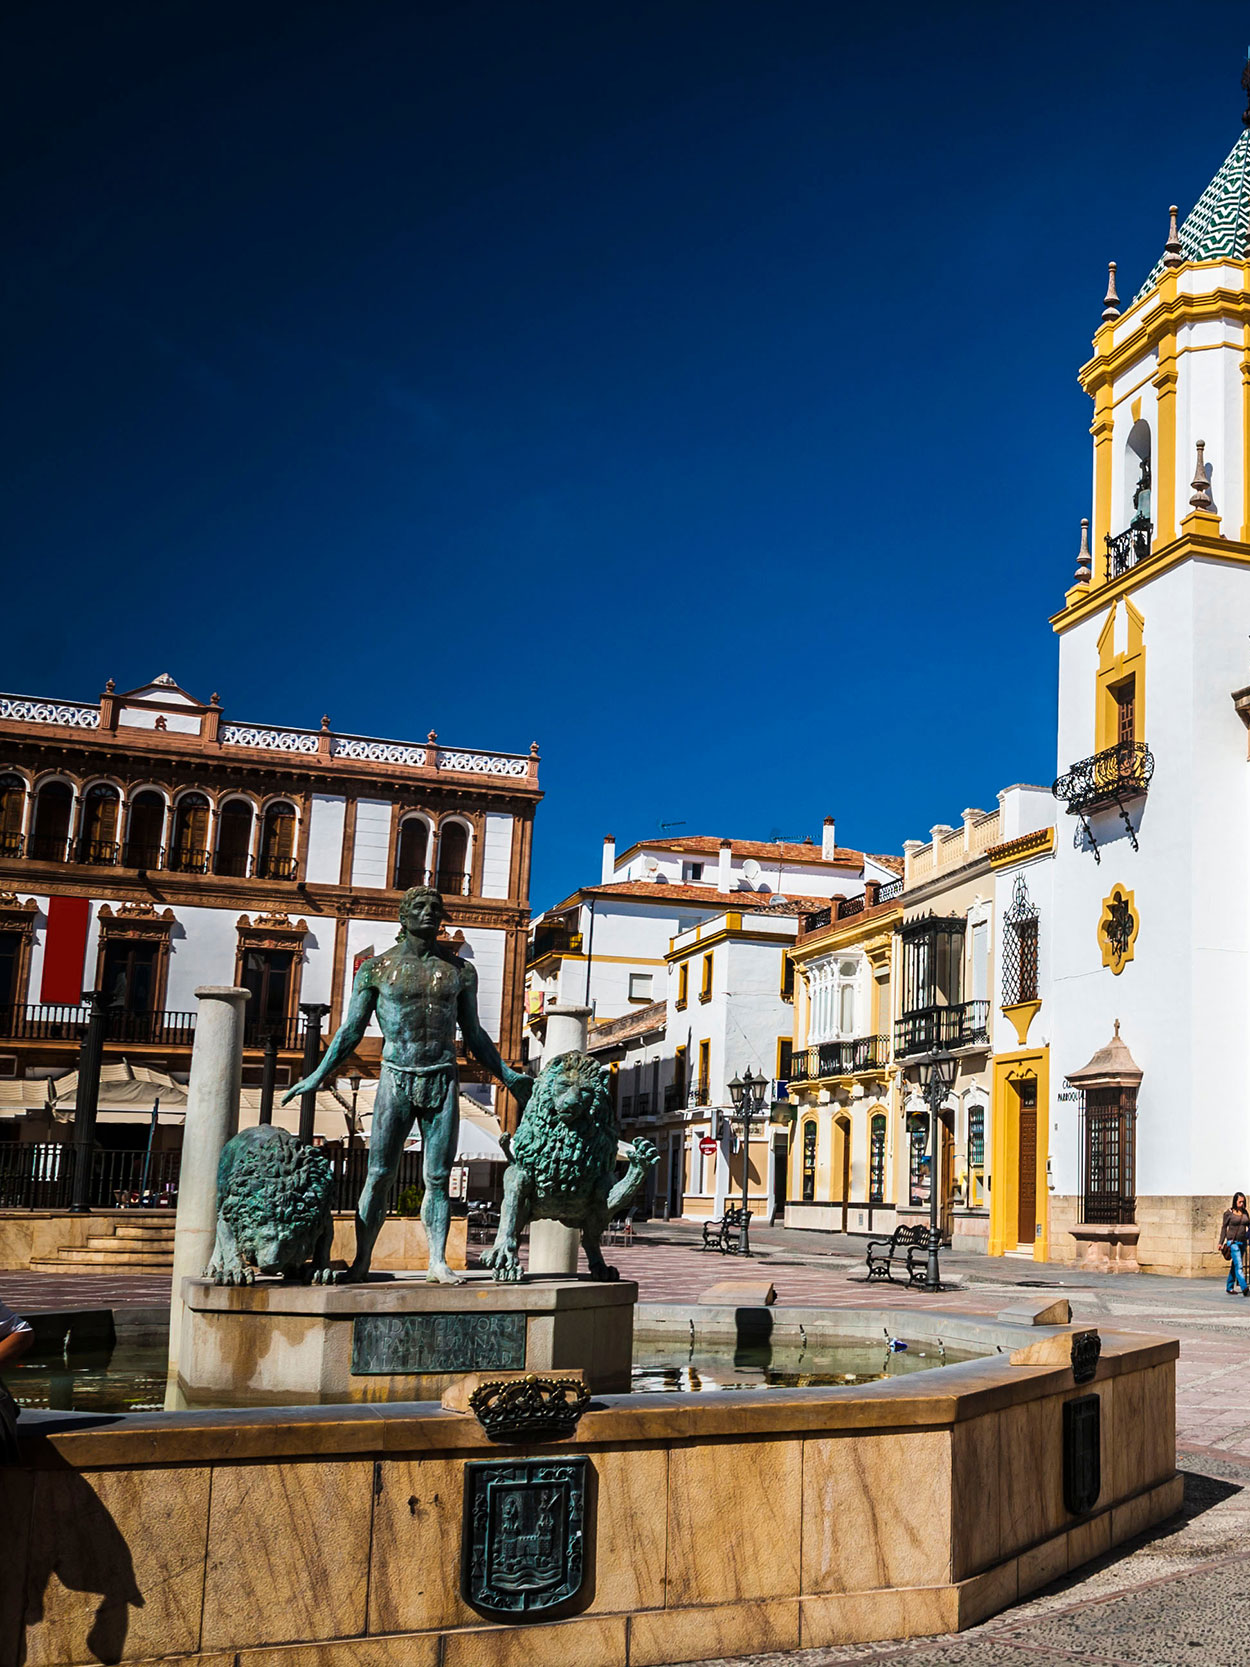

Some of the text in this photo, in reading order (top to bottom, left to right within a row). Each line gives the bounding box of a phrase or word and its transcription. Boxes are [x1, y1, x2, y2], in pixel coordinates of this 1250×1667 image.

[469, 1317, 499, 1333] POR
[505, 1317, 518, 1331] SI
[383, 1336, 425, 1352] PARA
[367, 1354, 377, 1370] Y
[381, 1353, 398, 1369] LA
